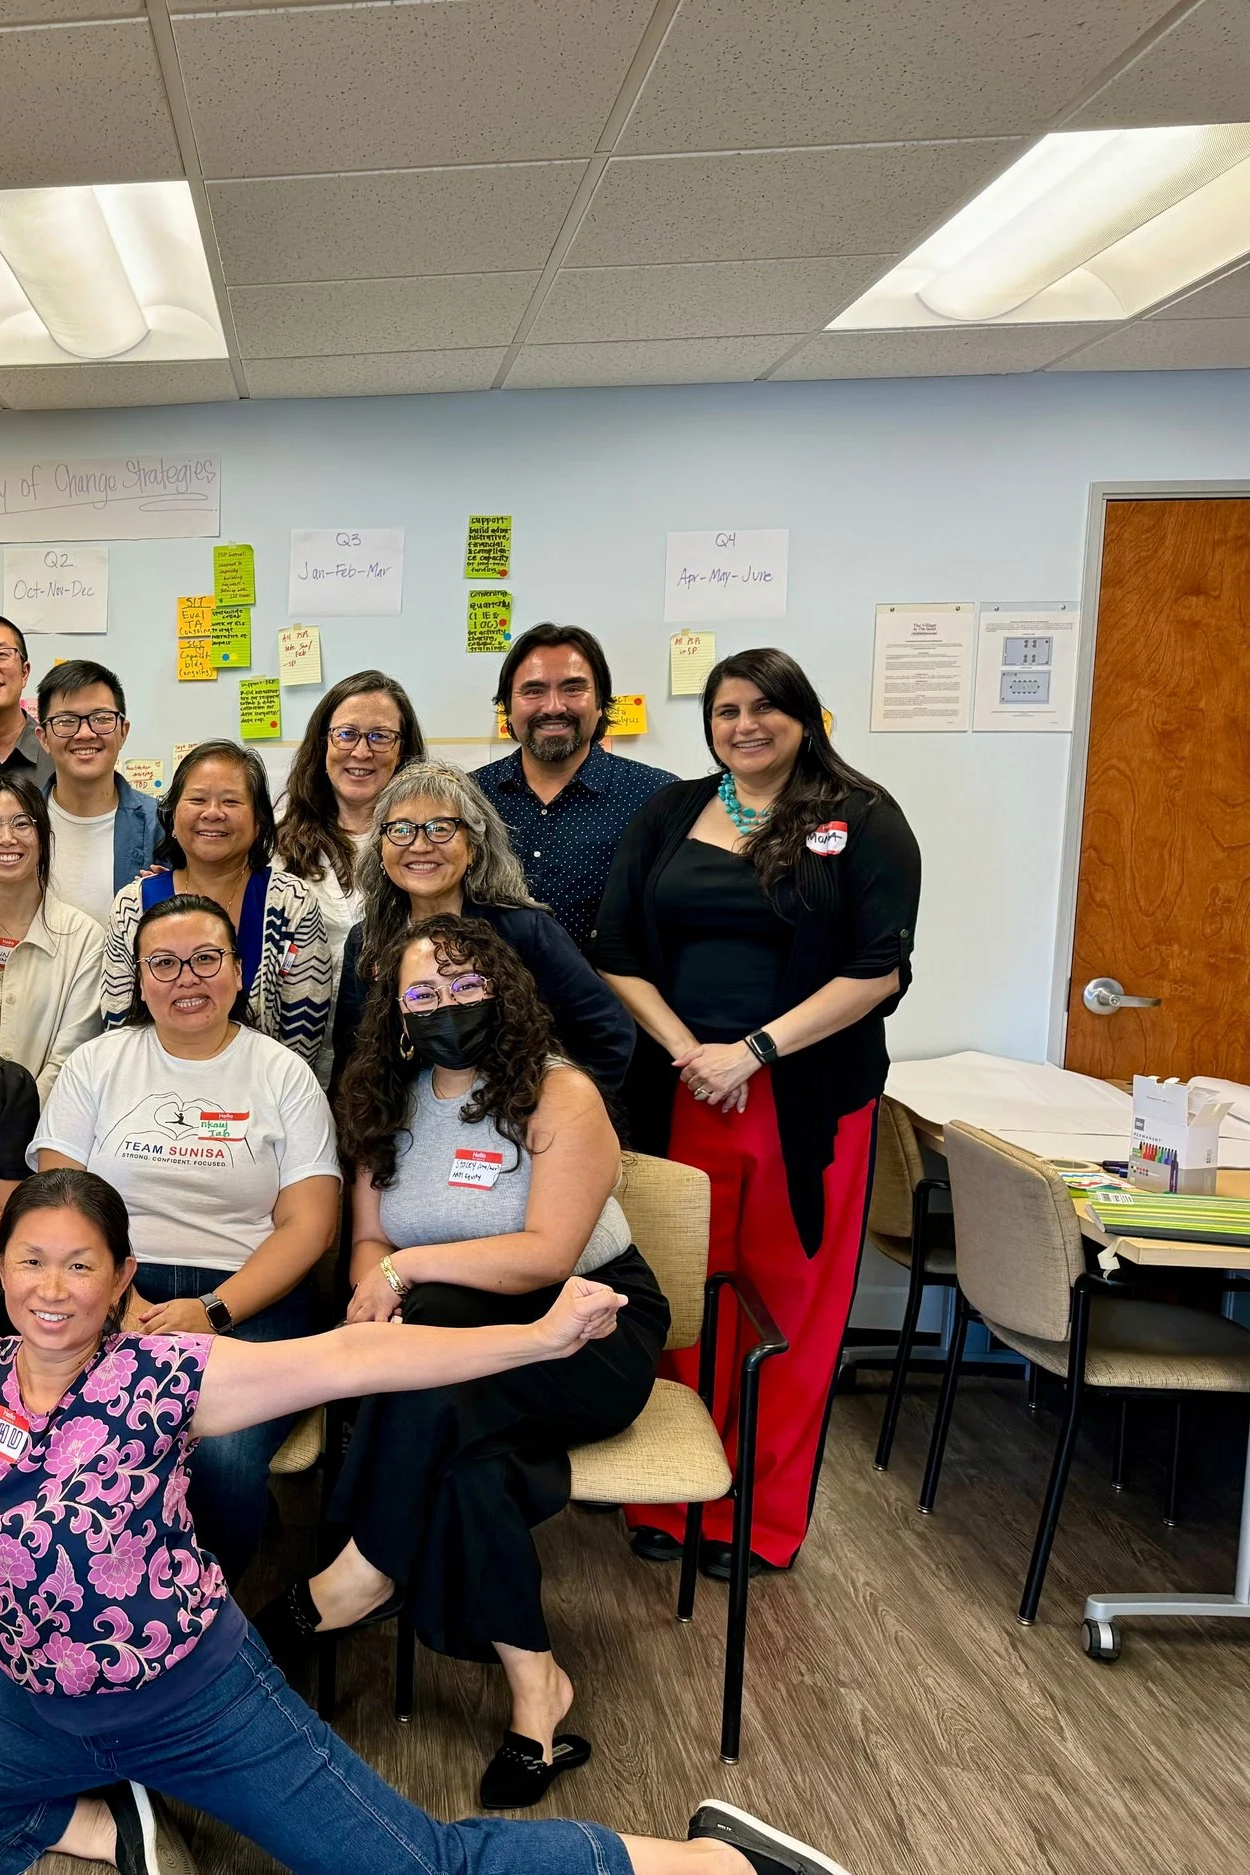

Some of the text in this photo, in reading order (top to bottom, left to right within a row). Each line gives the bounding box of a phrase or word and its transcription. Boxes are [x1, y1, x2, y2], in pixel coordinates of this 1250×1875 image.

[20, 464, 42, 500] of
[55, 463, 117, 510] Change
[122, 458, 216, 494] Strategies
[336, 532, 362, 547] Q3
[715, 532, 736, 547] Q4
[44, 551, 74, 568] Q2
[13, 579, 95, 600] Oct-Nov-Dec
[125, 1141, 225, 1159] TEAM SUNISA
[122, 1152, 150, 1160] STRONG.
[152, 1156, 191, 1165] CONFIDENT.
[3, 1410, 16, 1420] Hello
